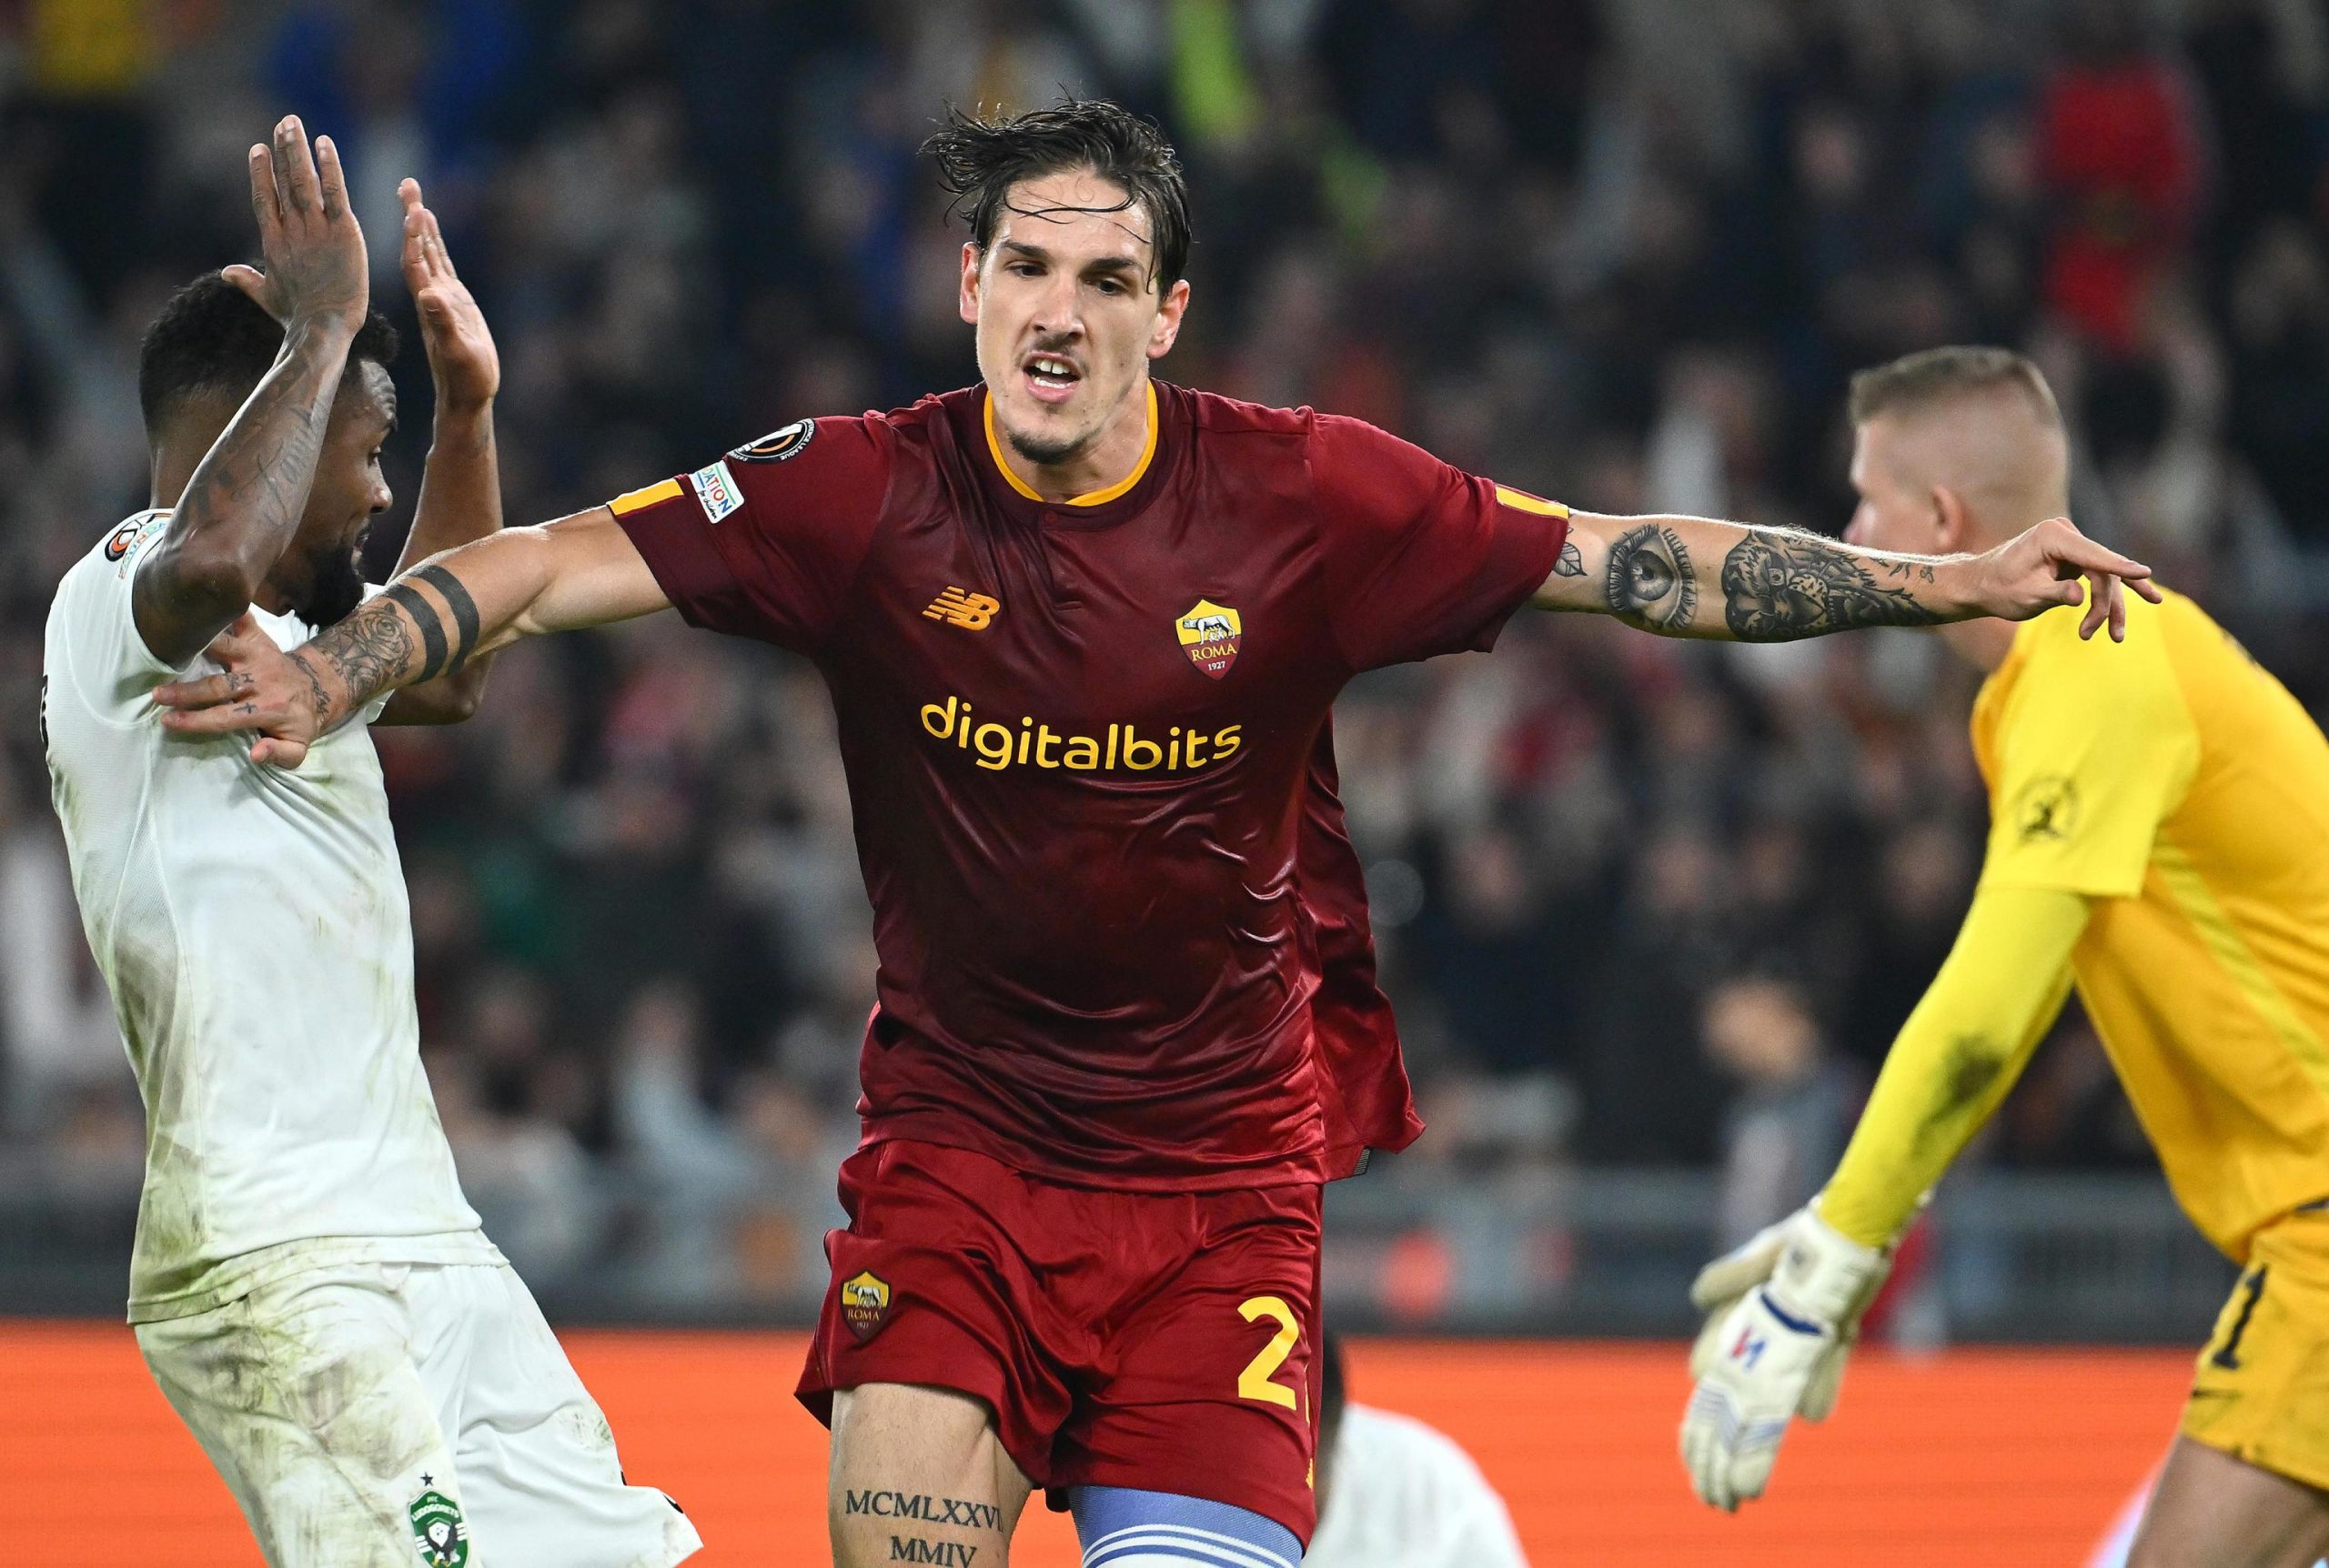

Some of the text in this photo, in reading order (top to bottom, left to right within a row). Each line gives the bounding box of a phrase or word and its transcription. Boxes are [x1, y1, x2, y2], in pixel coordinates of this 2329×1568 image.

[1191, 643, 1238, 661] ROMA
[1207, 660, 1226, 671] 1927
[921, 695, 1243, 770] digitalbits
[847, 1309, 880, 1321] ROMA
[2212, 1262, 2269, 1370] 1
[1237, 1296, 1311, 1424] 2
[889, 1535, 977, 1568] MMIV
